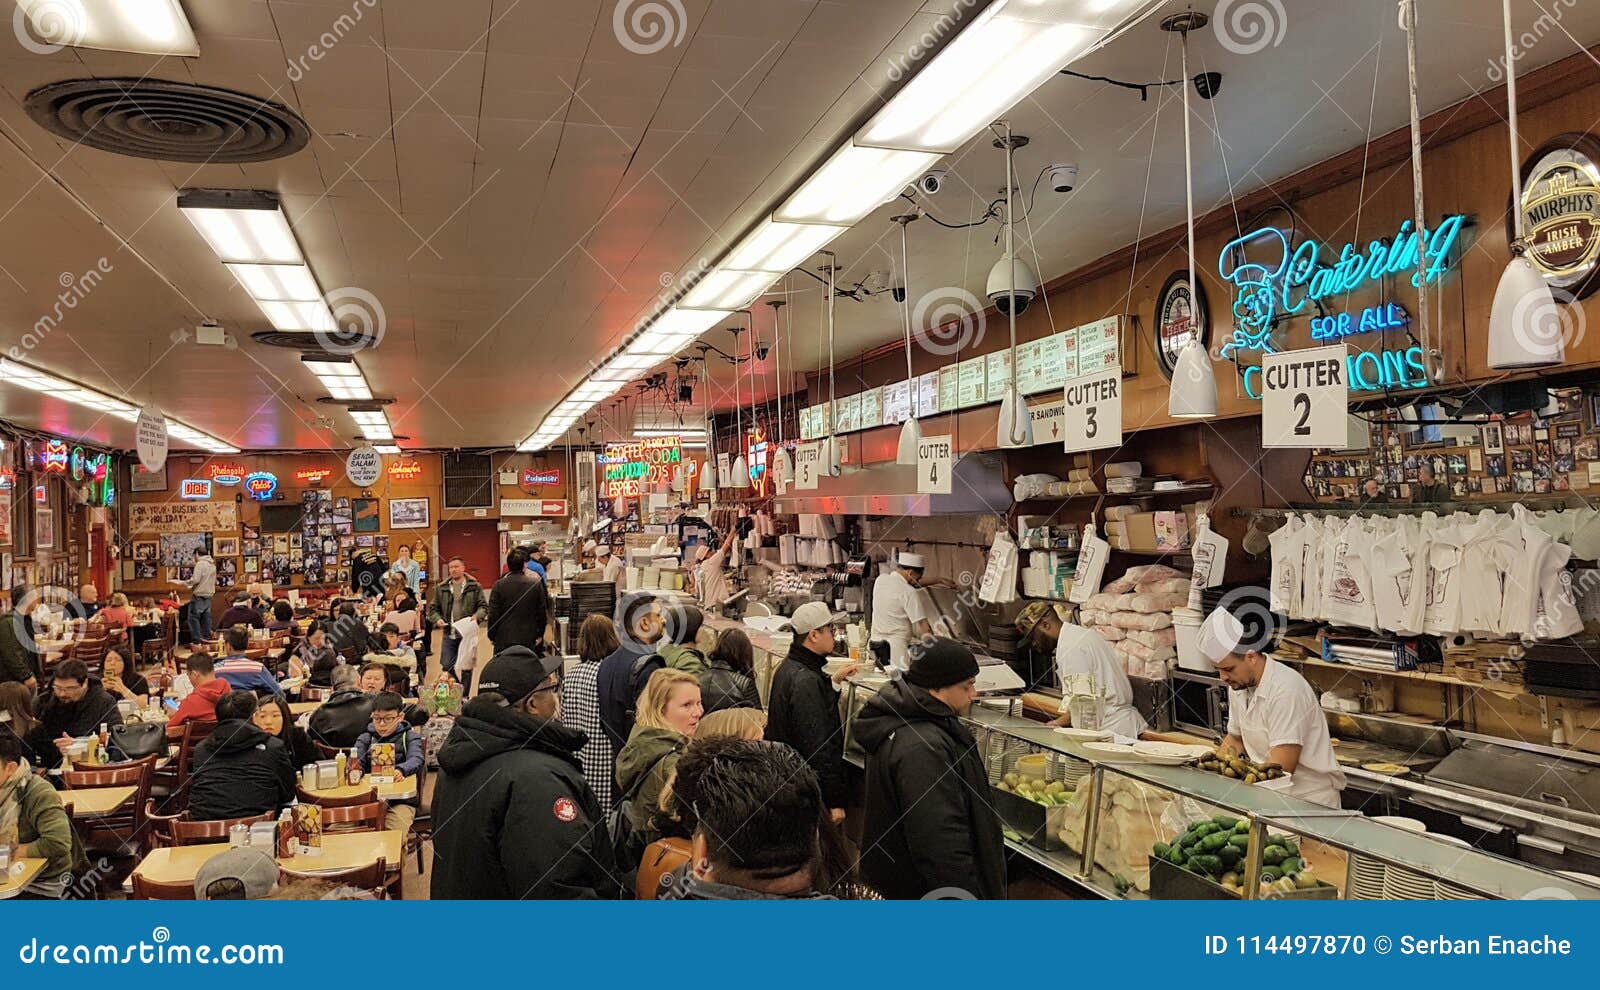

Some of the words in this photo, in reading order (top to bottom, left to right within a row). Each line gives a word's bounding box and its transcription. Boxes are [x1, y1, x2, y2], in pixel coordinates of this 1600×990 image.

[1546, 225, 1579, 242] IRISH
[1543, 237, 1583, 256] AMBER
[1283, 215, 1467, 313] Catering
[1359, 302, 1404, 333] ALL
[1265, 359, 1342, 391] CUTTER
[1066, 377, 1118, 406] CUTTER
[1085, 406, 1098, 439] 3
[1293, 392, 1311, 436] 2
[796, 449, 817, 462] CUTTER
[919, 443, 949, 459] CUTTER
[803, 465, 809, 483] 5
[930, 462, 938, 485] 4
[171, 504, 208, 514] BUSINESS
